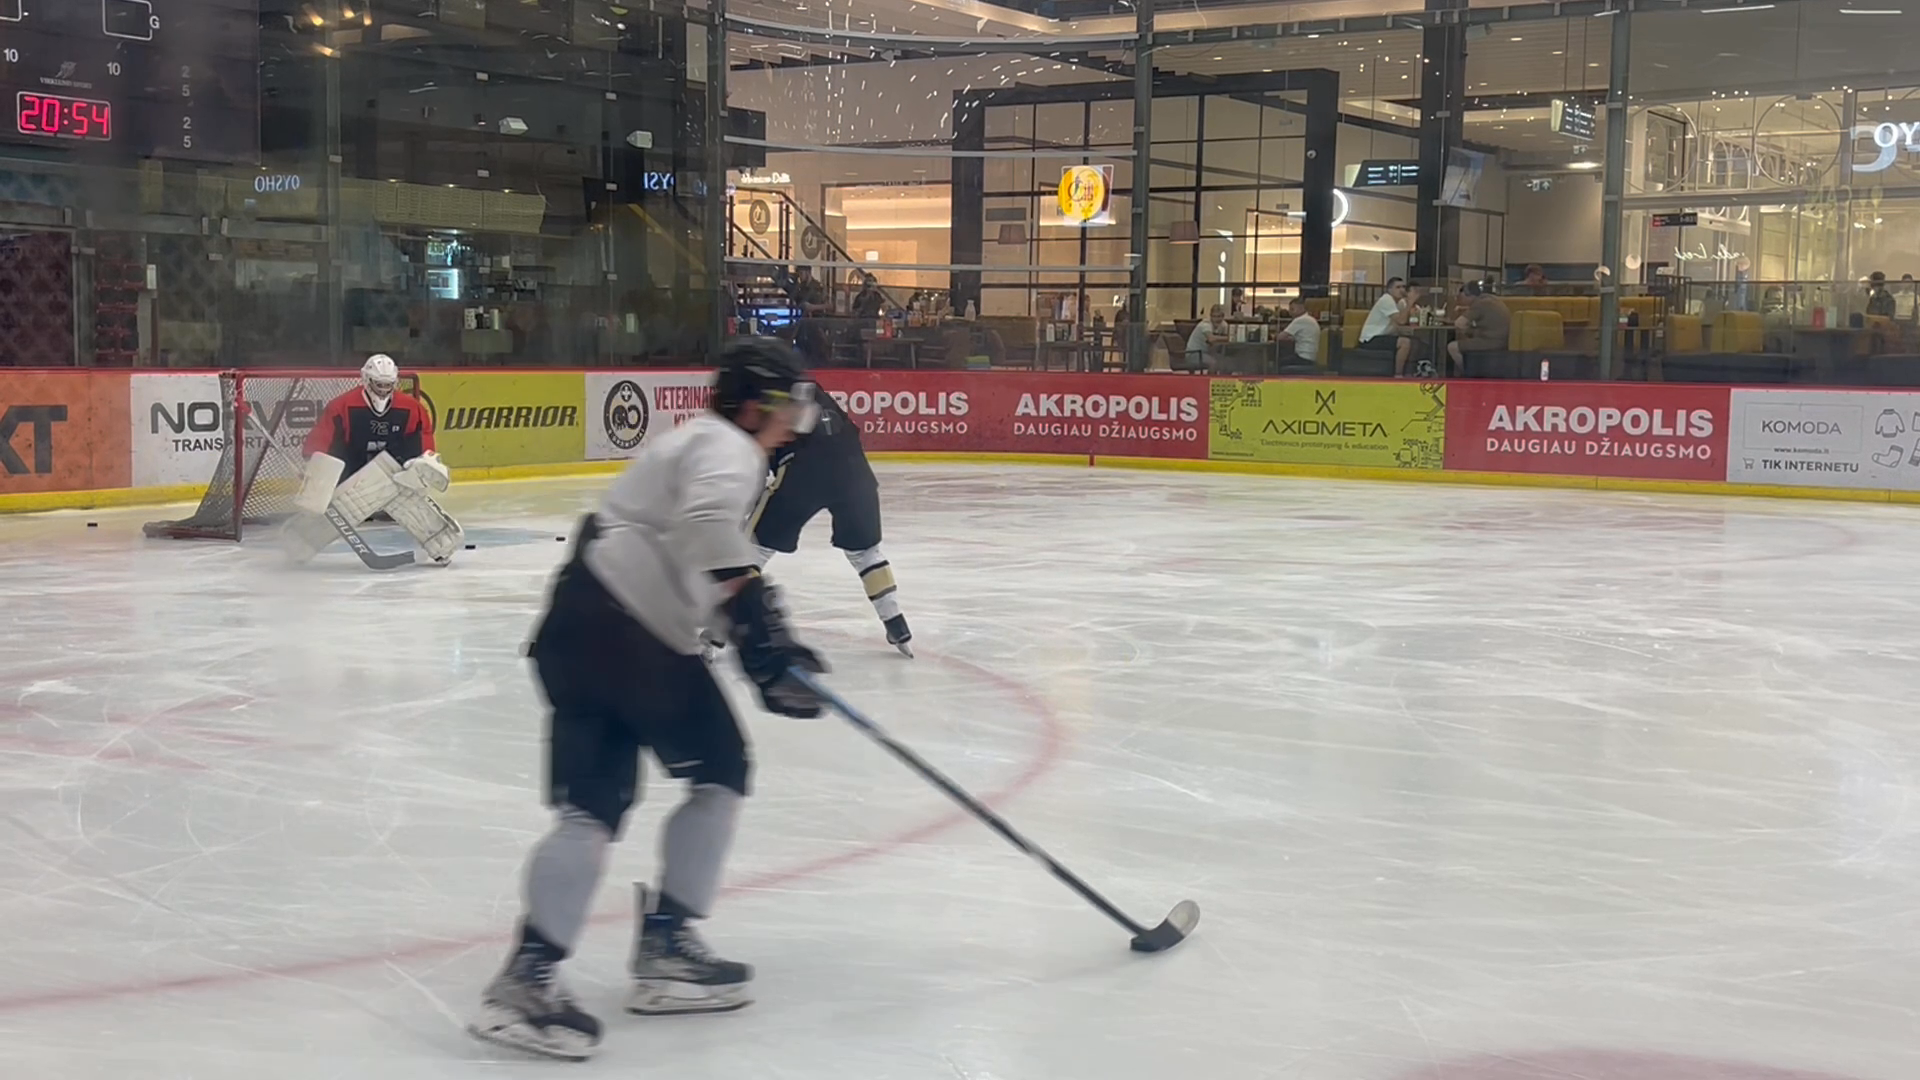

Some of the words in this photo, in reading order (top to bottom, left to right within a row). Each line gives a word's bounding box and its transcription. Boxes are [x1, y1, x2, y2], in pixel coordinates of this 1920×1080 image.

[149, 16, 160, 29] G
[3, 48, 19, 62] 10
[106, 62, 121, 76] 10
[181, 65, 190, 78] 2
[182, 84, 190, 97] 5
[20, 96, 110, 135] 20:54
[182, 116, 192, 129] 2
[183, 135, 192, 148] 5
[824, 391, 969, 416] ROPOLIS
[1014, 393, 1199, 422] AKROPOLIS
[443, 405, 578, 431] WARRIOR
[864, 417, 968, 434] DŽIAUGSMO
[1487, 405, 1714, 437] AKROPOLIS
[1013, 422, 1092, 437] DAUGIAU
[1099, 421, 1198, 441] DŽIAUGSMO
[1262, 419, 1388, 438] AXIOMETA
[1761, 420, 1842, 435] KOMODA
[1486, 438, 1577, 455] DAUGIAU
[1585, 437, 1711, 460] DŽIAUGSMO
[1762, 459, 1782, 470] TIK
[1784, 460, 1859, 473] INTERNETU
